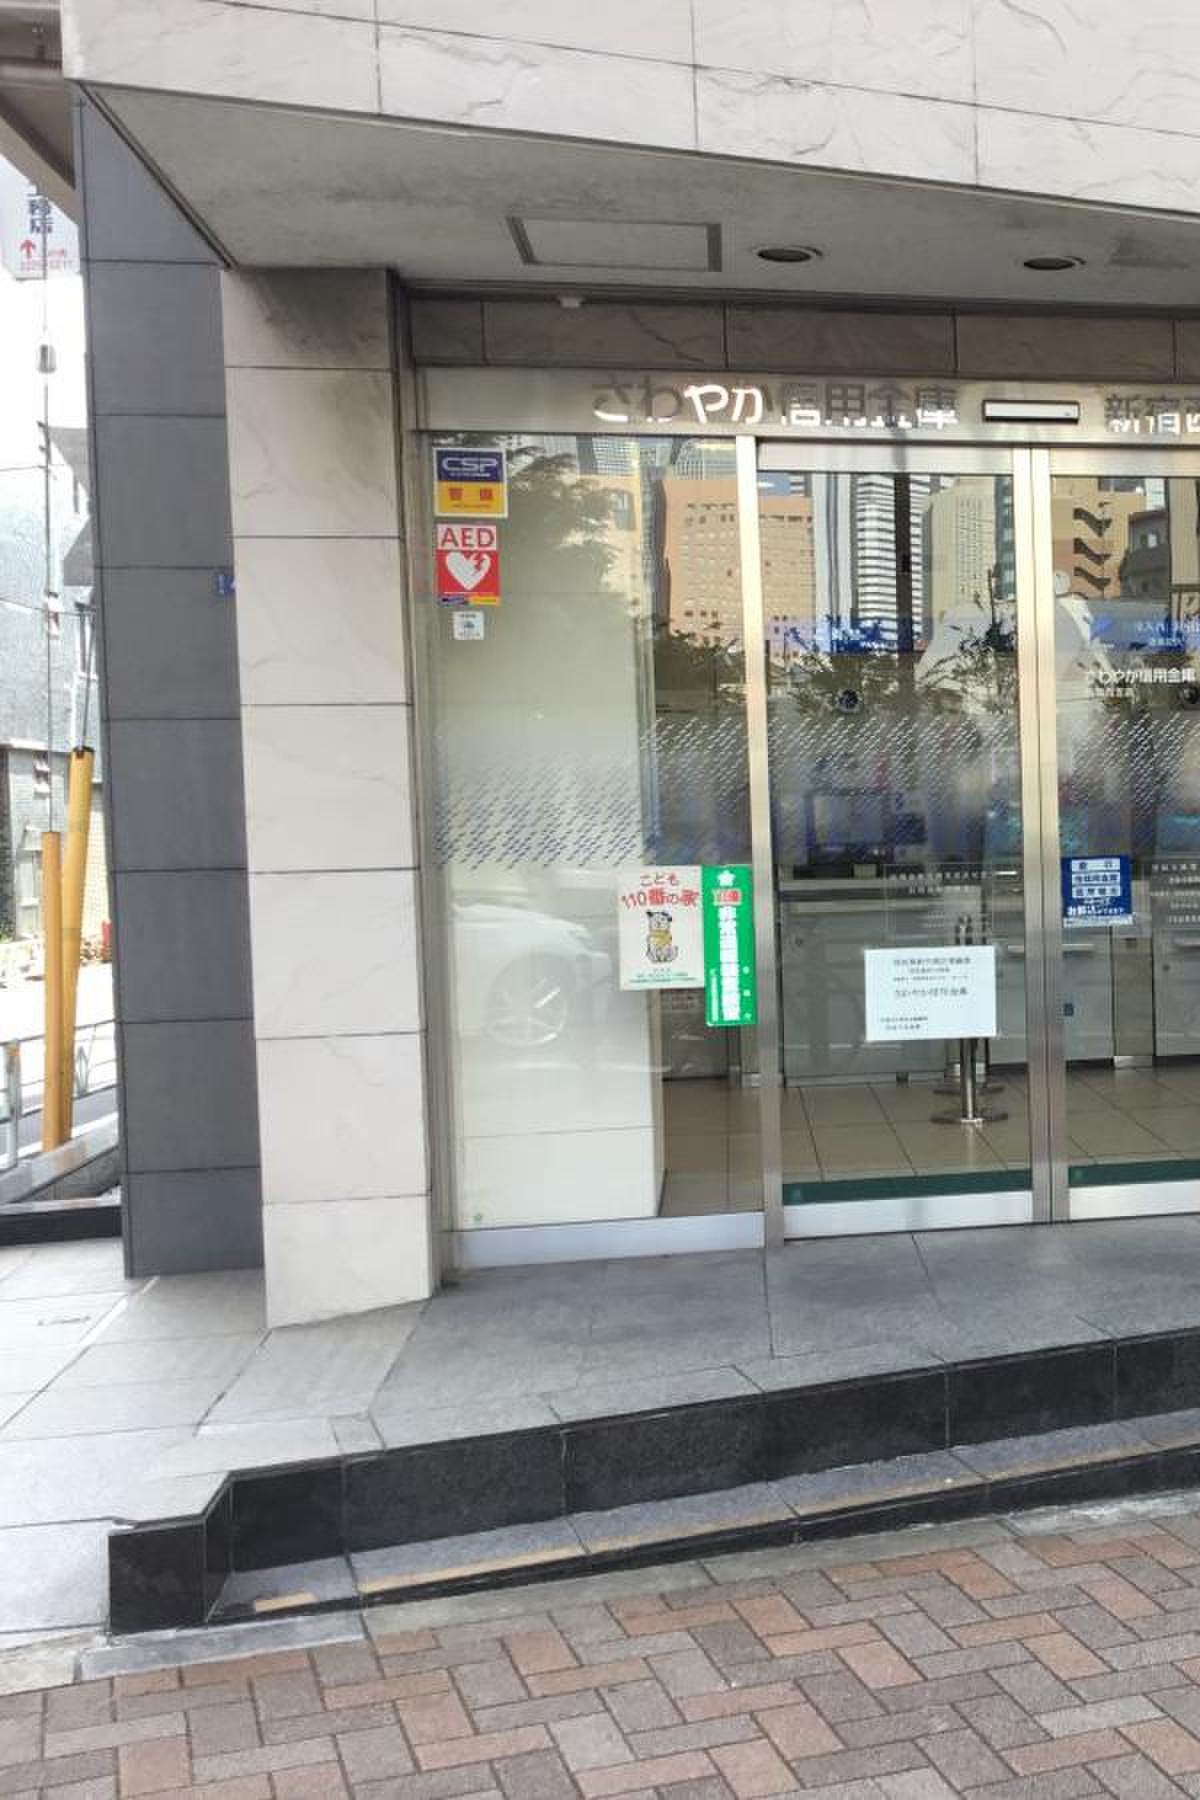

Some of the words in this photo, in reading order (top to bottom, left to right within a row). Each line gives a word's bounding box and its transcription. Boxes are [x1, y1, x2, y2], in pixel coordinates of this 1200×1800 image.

[592, 377, 961, 430] さわやか信用金庫
[442, 456, 498, 473] CSP
[441, 527, 495, 549] AED
